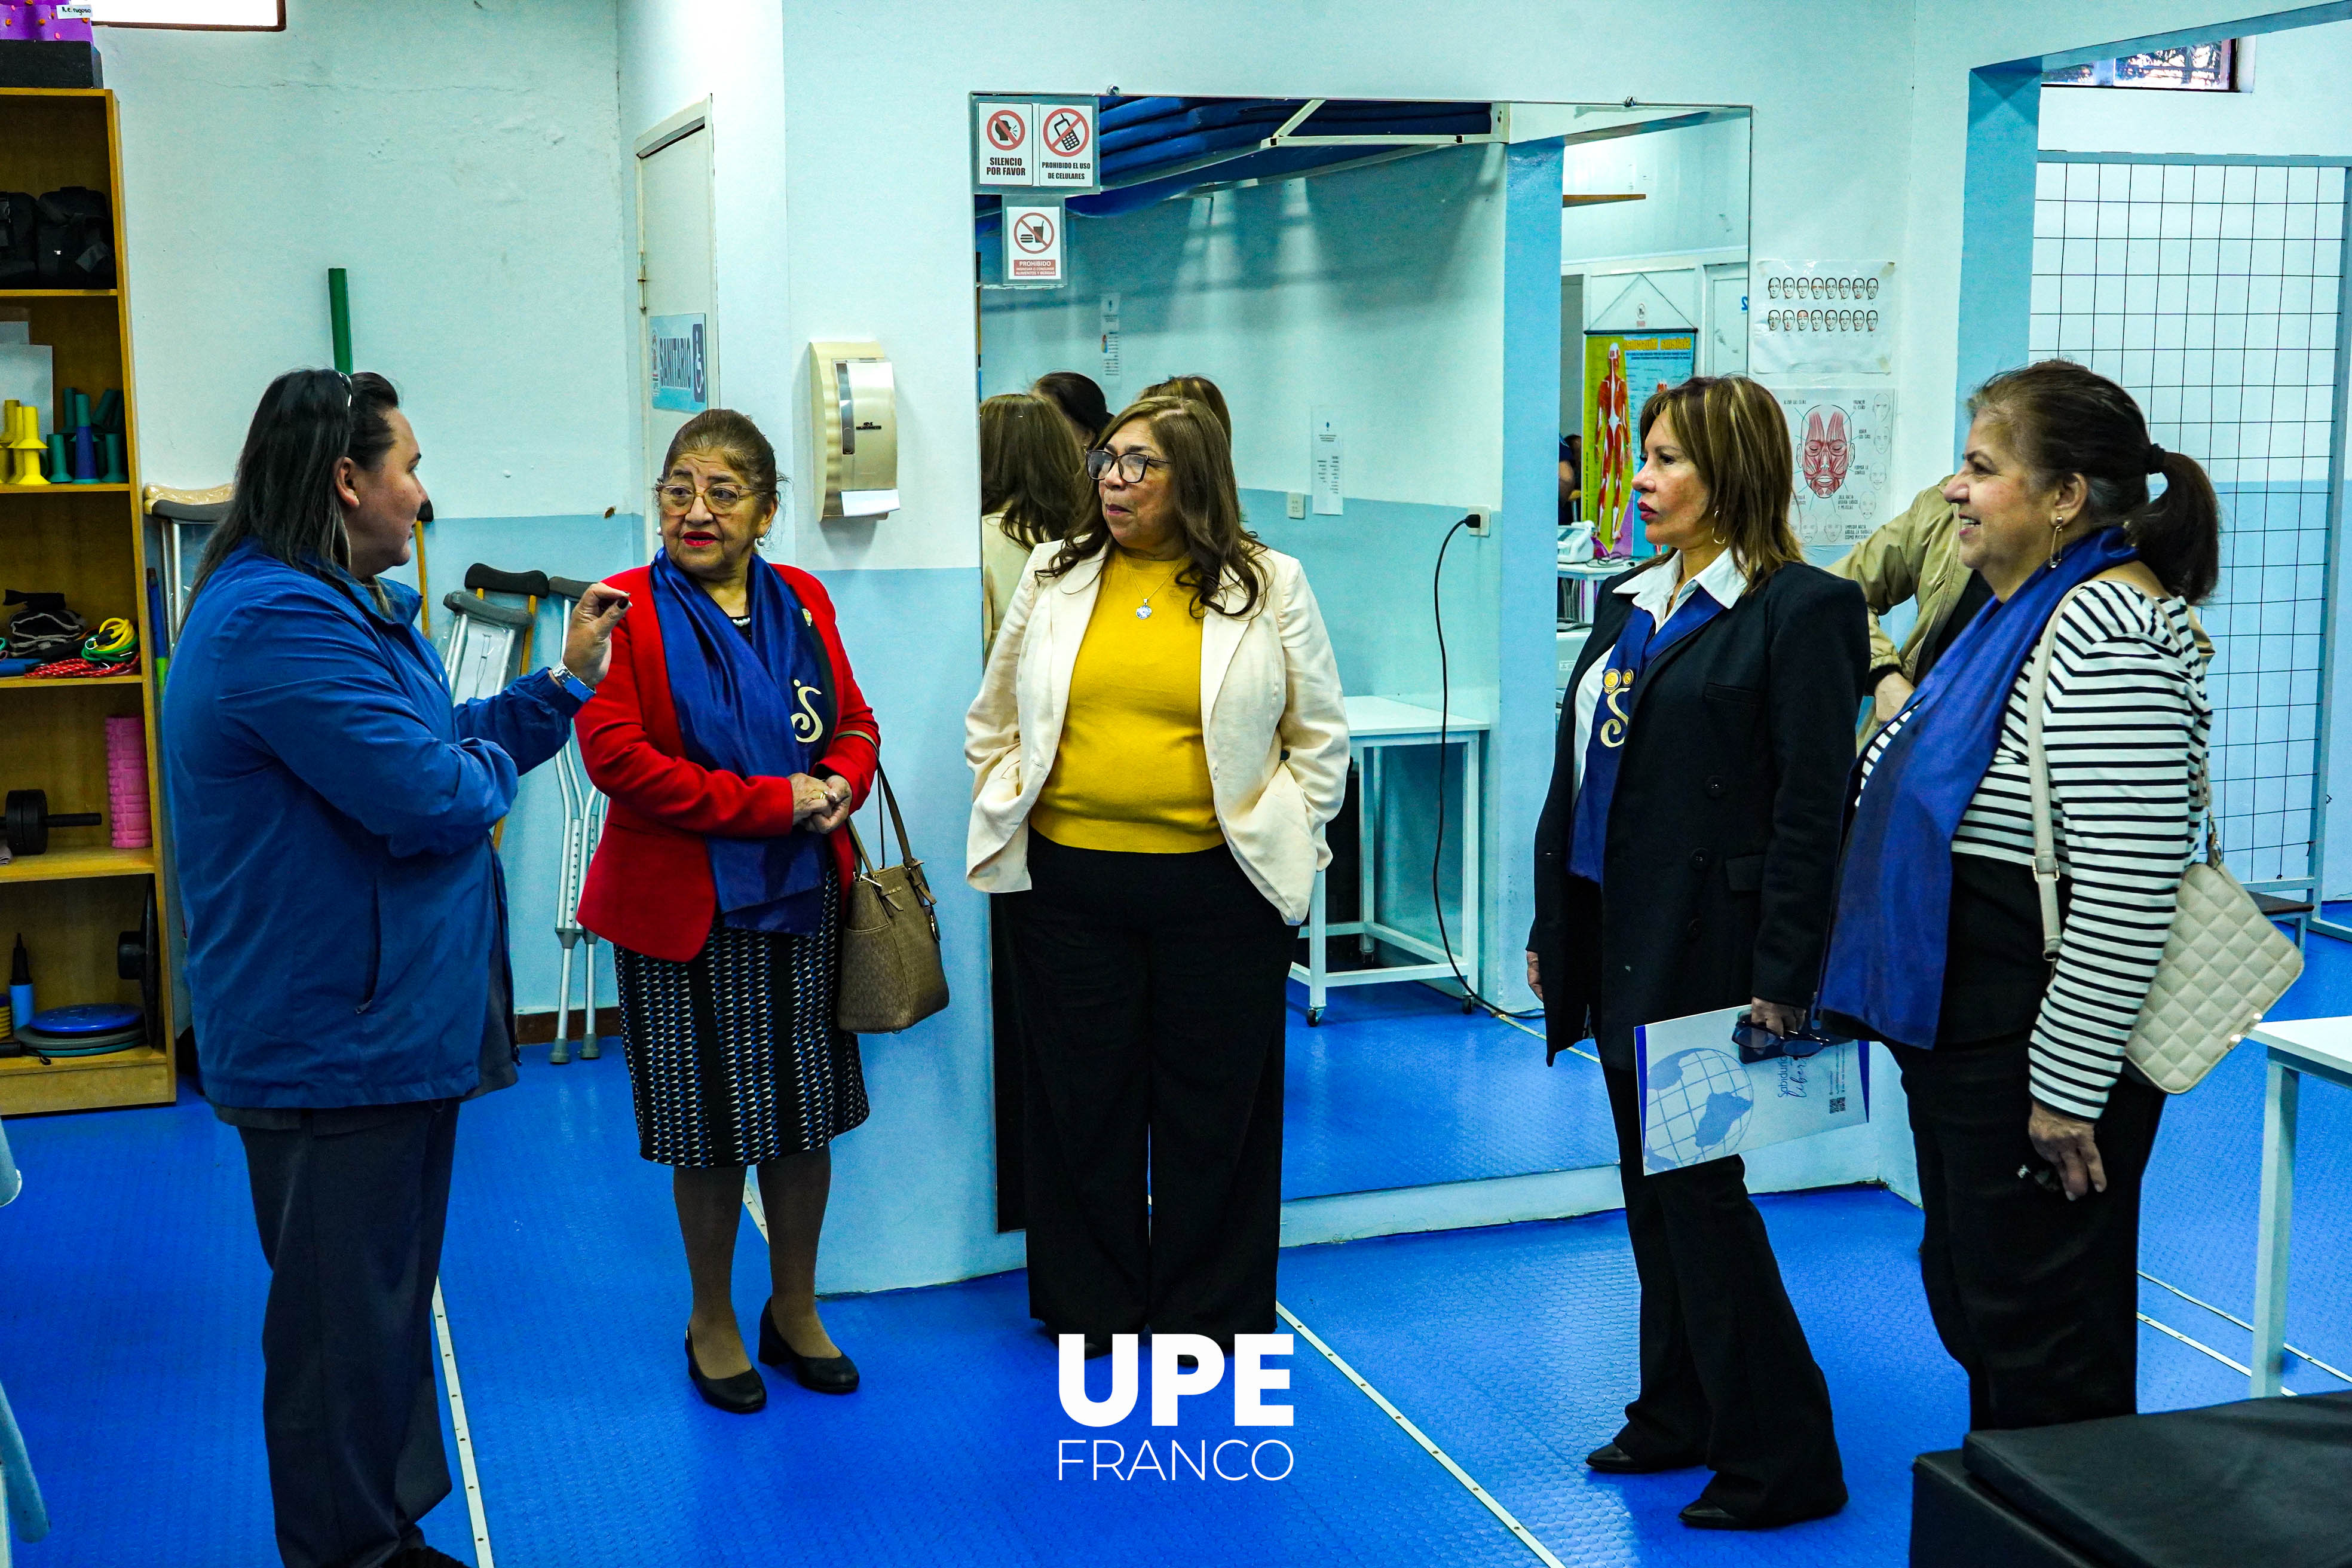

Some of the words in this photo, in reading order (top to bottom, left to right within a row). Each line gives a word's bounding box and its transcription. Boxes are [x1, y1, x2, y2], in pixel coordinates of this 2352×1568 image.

[990, 157, 1022, 166] SILENCIO
[1003, 167, 1025, 176] FAVOR
[660, 337, 691, 388] SANITARIO
